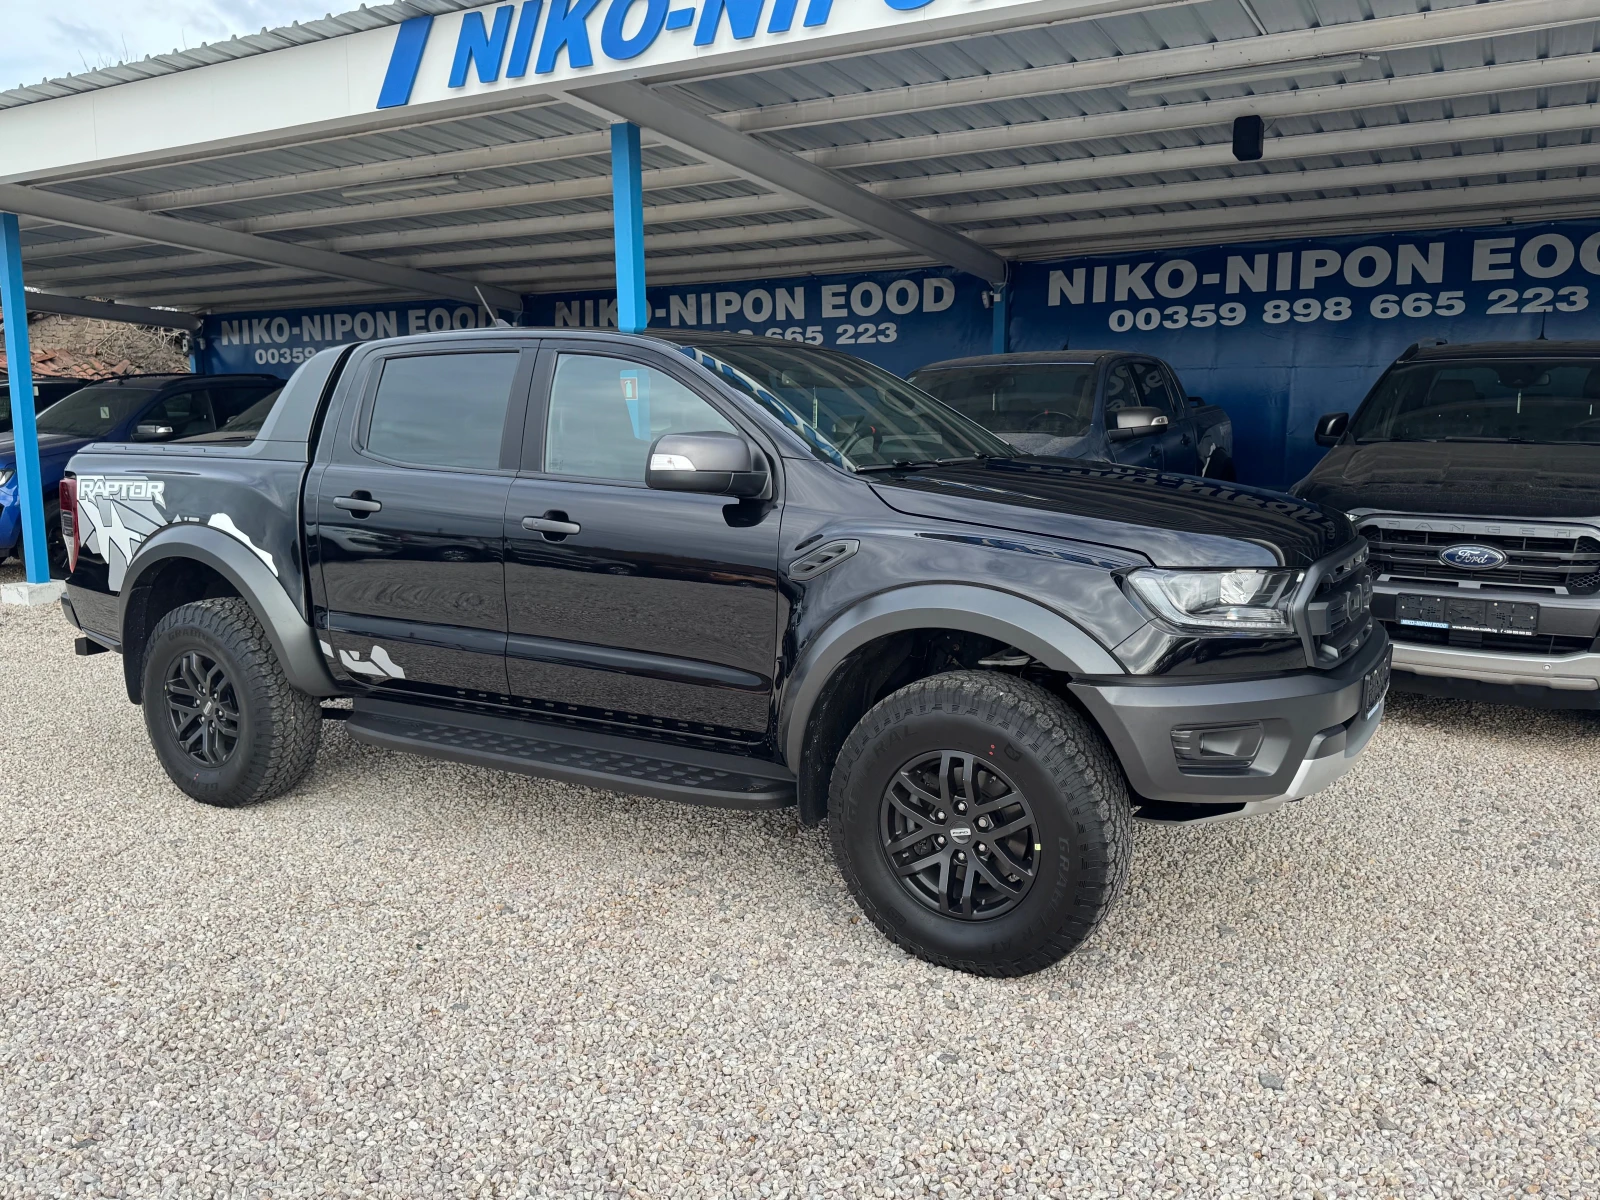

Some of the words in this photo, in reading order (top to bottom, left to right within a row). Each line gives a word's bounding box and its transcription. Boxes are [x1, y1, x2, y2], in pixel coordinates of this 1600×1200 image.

[448, 0, 936, 89] NIKO-N
[1047, 241, 1446, 307] NIKO-NIPON
[554, 287, 806, 328] NIK-NIPON
[821, 277, 956, 318] EOOD
[1108, 302, 1247, 332] 00359
[1262, 296, 1352, 324] 898
[1369, 290, 1466, 319] 665
[1485, 285, 1589, 315] 223
[220, 310, 398, 346] NIKO-NIPON
[836, 322, 898, 345] 223
[79, 477, 167, 510] RAPTOR
[1385, 519, 1571, 538] RANGER
[1455, 549, 1489, 565] Ford
